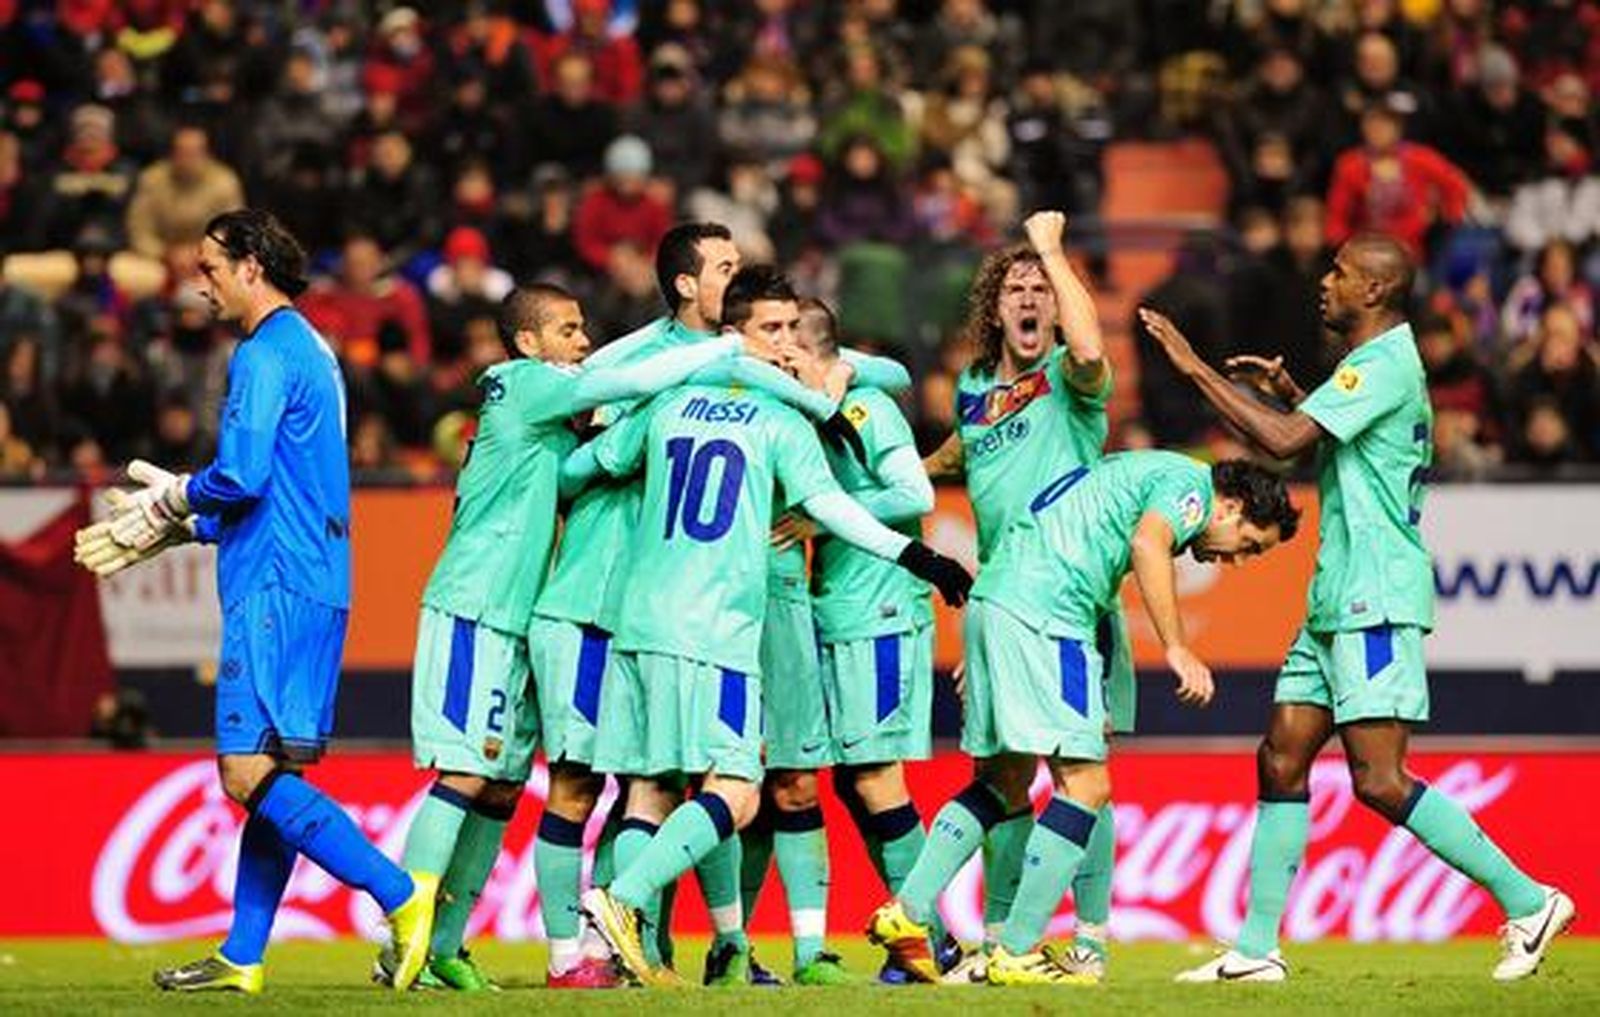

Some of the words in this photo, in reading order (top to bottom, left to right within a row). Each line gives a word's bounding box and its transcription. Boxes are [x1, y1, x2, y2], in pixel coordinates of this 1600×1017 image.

[681, 397, 759, 425] MESSI
[664, 436, 746, 543] 10
[487, 688, 507, 733] 2
